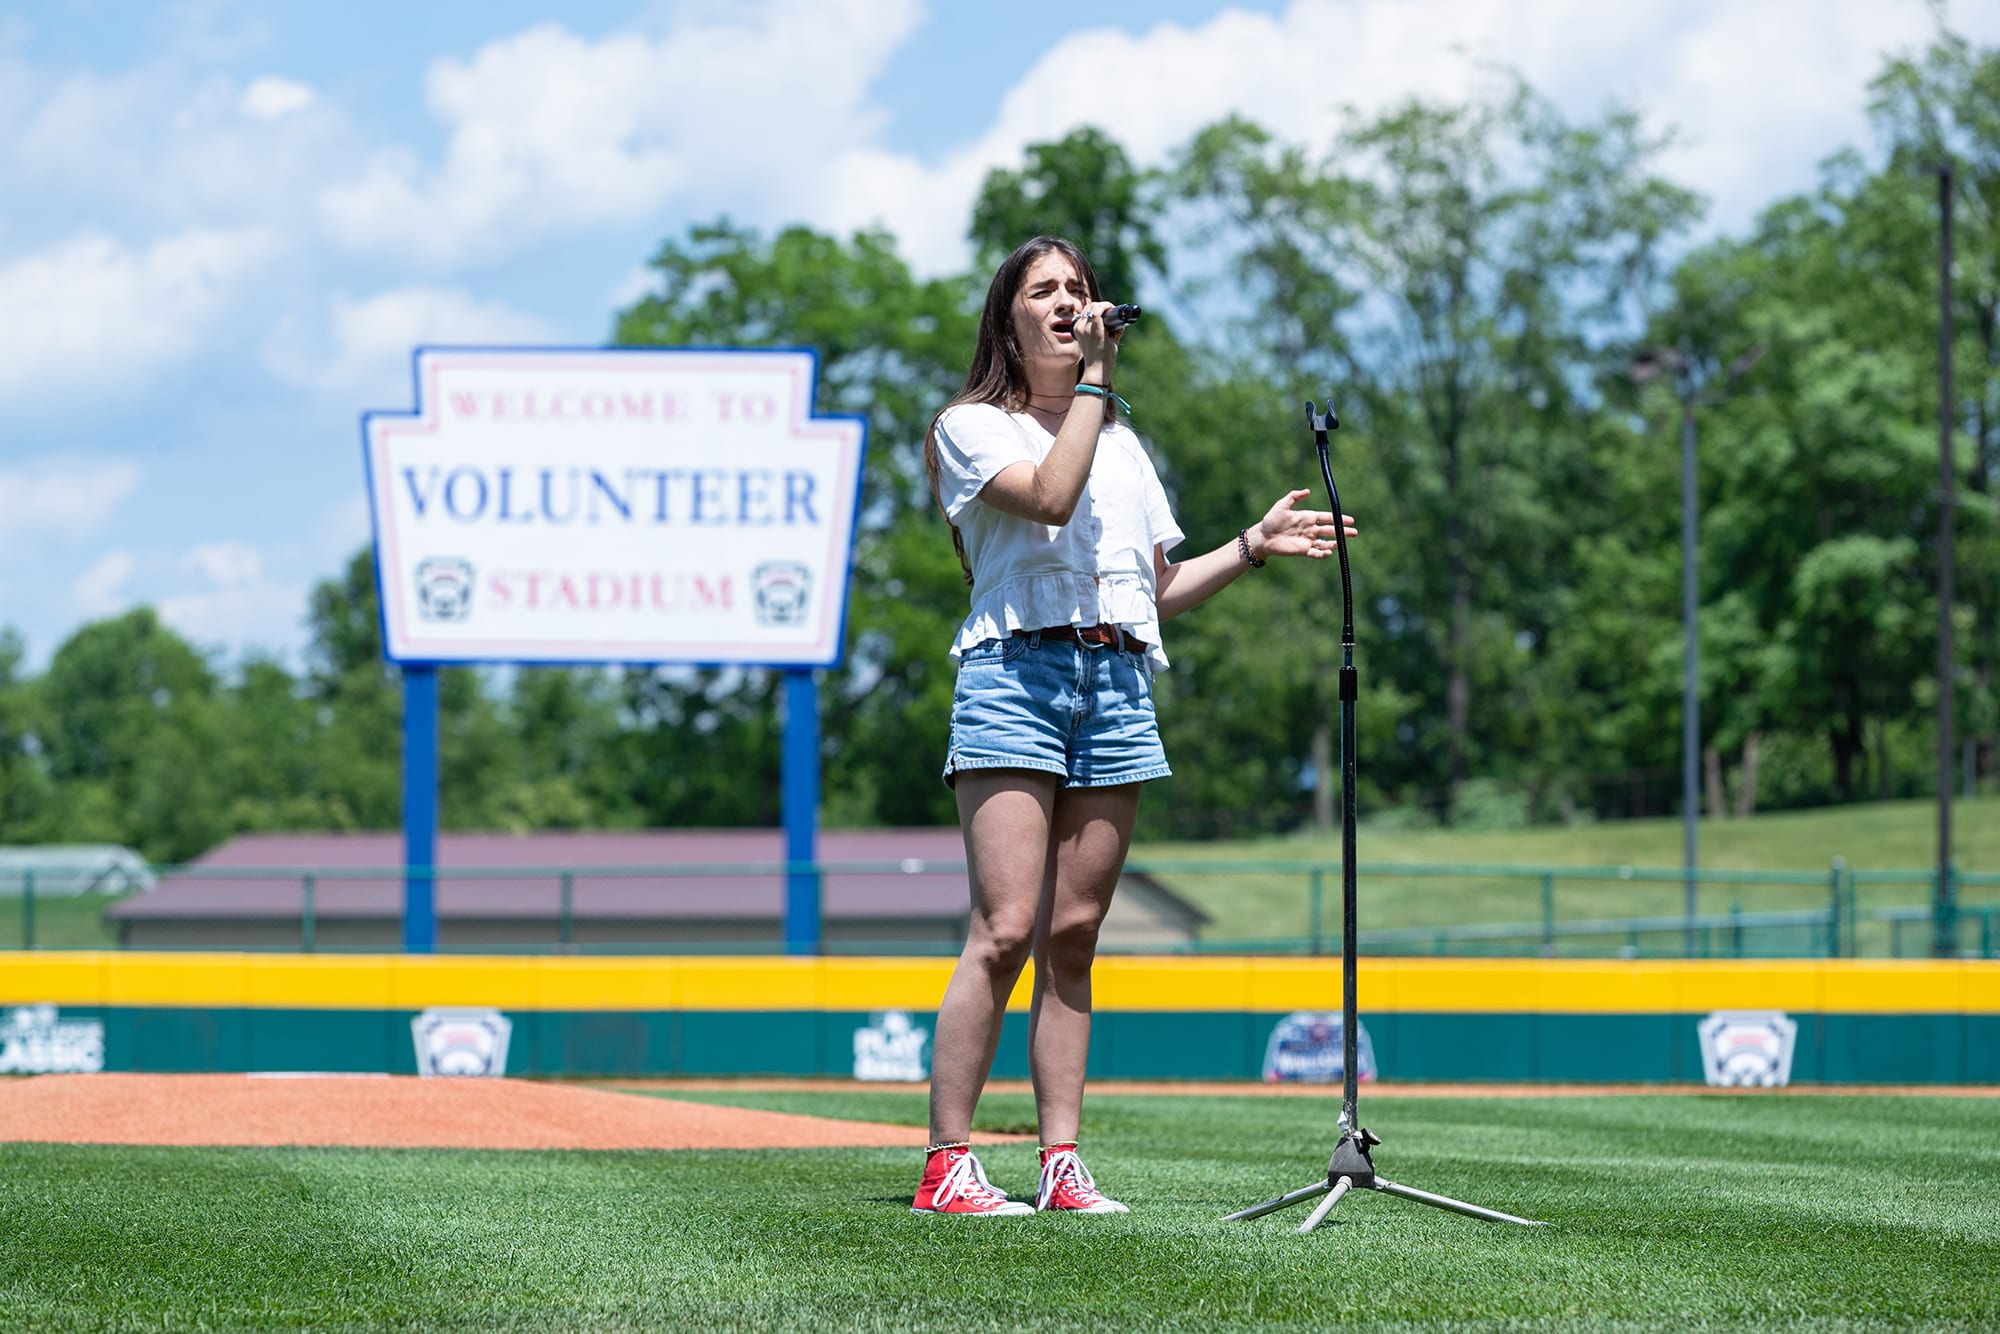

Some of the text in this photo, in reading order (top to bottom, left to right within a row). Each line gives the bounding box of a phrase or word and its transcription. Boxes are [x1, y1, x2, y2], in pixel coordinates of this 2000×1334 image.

[450, 390, 777, 423] WELCOME TO
[402, 464, 820, 526] VOLUNTEER
[488, 569, 734, 611] STADIUM
